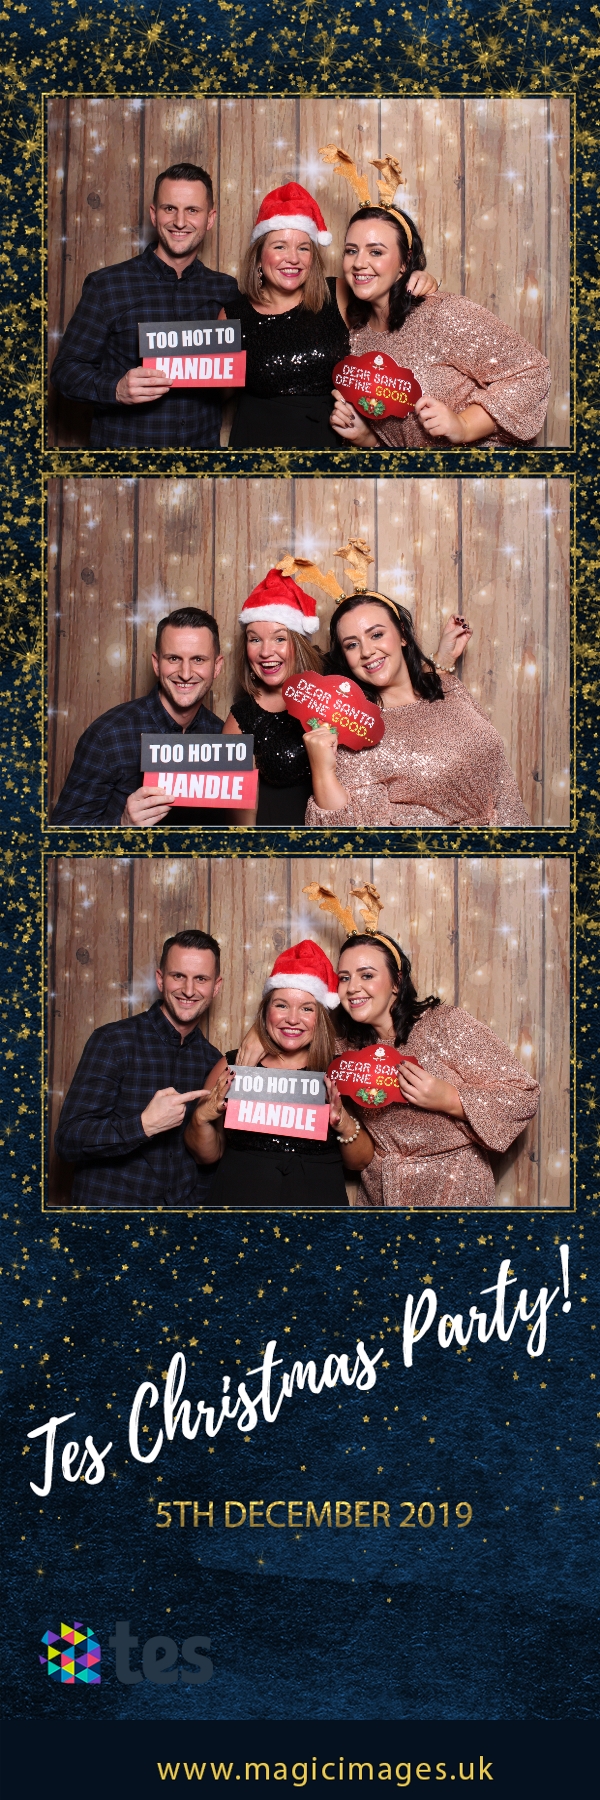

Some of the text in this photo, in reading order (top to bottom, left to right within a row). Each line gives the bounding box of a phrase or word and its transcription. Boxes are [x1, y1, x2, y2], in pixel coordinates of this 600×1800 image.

[146, 327, 235, 349] TOO HOT TO
[156, 357, 233, 380] HANDLE
[343, 365, 411, 392] DEAR SANTA
[335, 374, 371, 393] DEFINE
[285, 686, 330, 717] DEFINE
[297, 679, 375, 728] DEAR SANTA
[149, 743, 247, 763] TOO HOT TO
[157, 772, 244, 800] HANDLE
[331, 1070, 400, 1088] DEFINE GOO
[339, 1060, 399, 1076] DEAR SAN
[234, 1075, 320, 1095] TOO HOT TO
[238, 1100, 317, 1131] HANDLE
